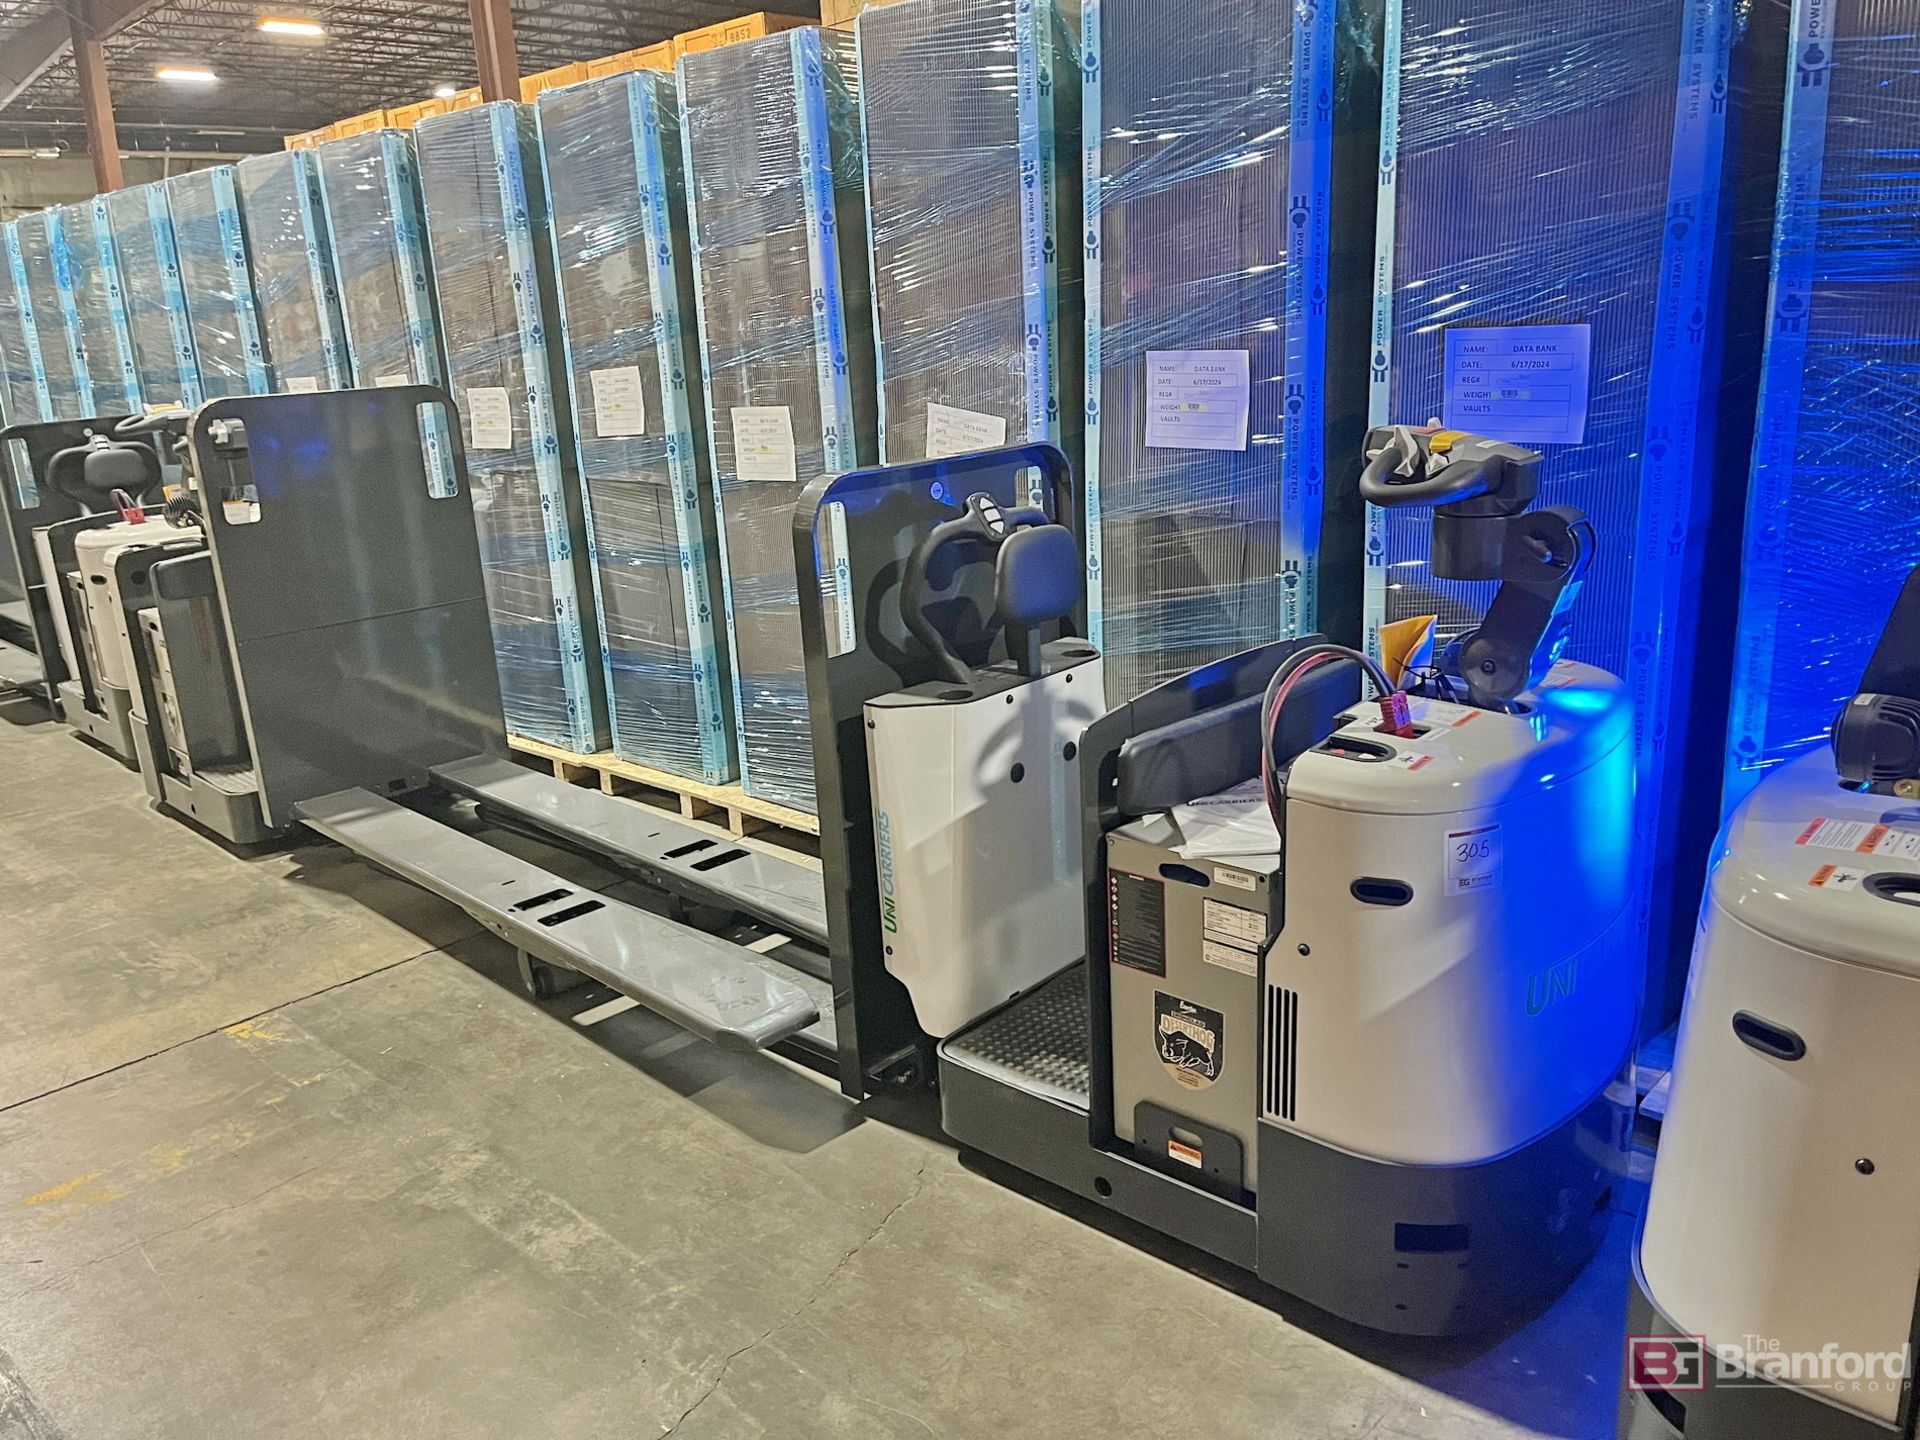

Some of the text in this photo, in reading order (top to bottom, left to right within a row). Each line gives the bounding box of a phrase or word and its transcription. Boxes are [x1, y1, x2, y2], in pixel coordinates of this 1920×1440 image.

[1300, 31, 1310, 126] POWER SYSTEMS
[1687, 8, 1706, 119] POWER SYSTEMS
[1315, 190, 1323, 237] SYSTEMS
[1295, 232, 1304, 268] POWER
[1665, 246, 1684, 349] POWER SYSTEMS
[1310, 379, 1318, 422] SYSTEMS
[1290, 458, 1298, 500] SYSTEMS
[1646, 465, 1664, 561] POWER SYSTEMS
[1305, 555, 1313, 595] SYSTEMS
[1635, 668, 1648, 704] POWER
[1457, 840, 1489, 862] 305
[1526, 959, 1577, 1016] UNI
